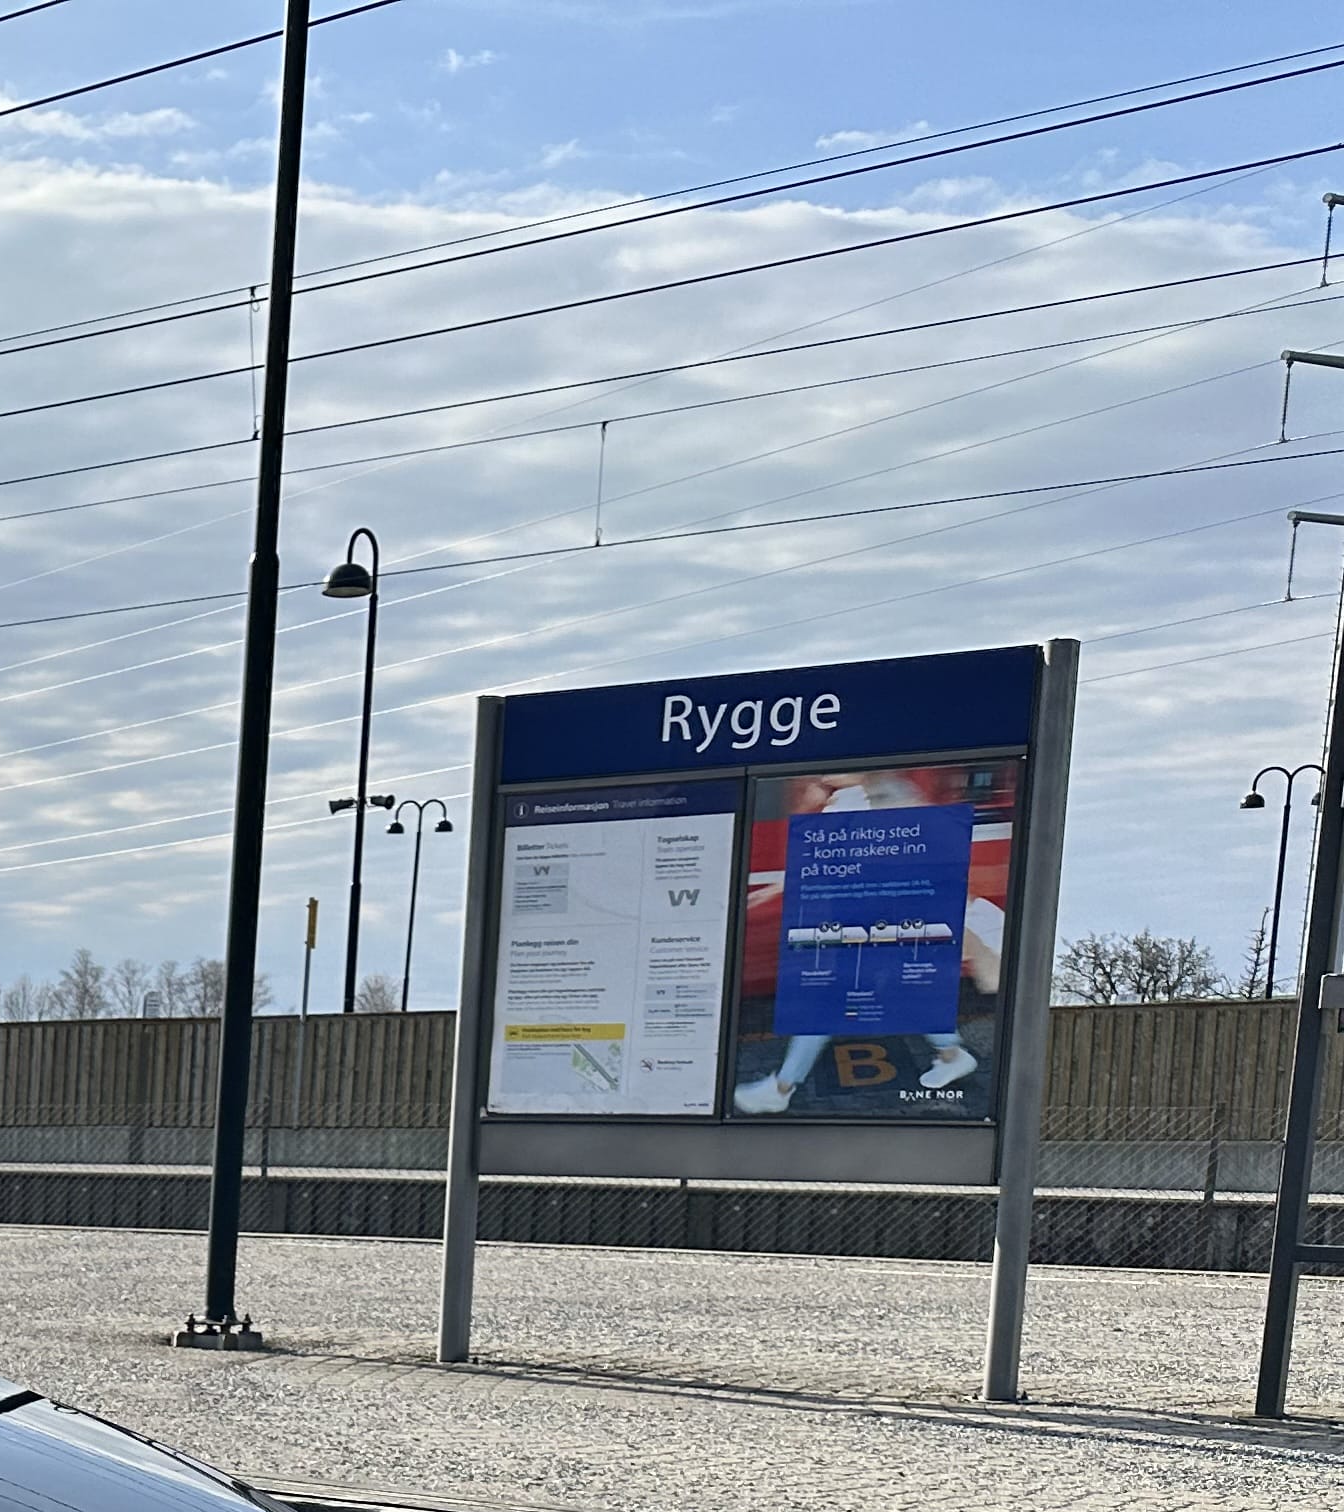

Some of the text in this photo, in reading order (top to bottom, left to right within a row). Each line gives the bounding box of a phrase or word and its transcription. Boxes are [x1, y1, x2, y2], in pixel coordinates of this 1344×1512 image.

[661, 693, 841, 753] Rygge
[804, 824, 921, 844] Stå på riktig sted
[813, 846, 846, 859] kom
[849, 844, 900, 857] raskere
[903, 842, 927, 854] inn
[800, 862, 863, 879] på toget
[834, 1043, 897, 1087] B
[899, 1090, 964, 1101] BANE NOR
